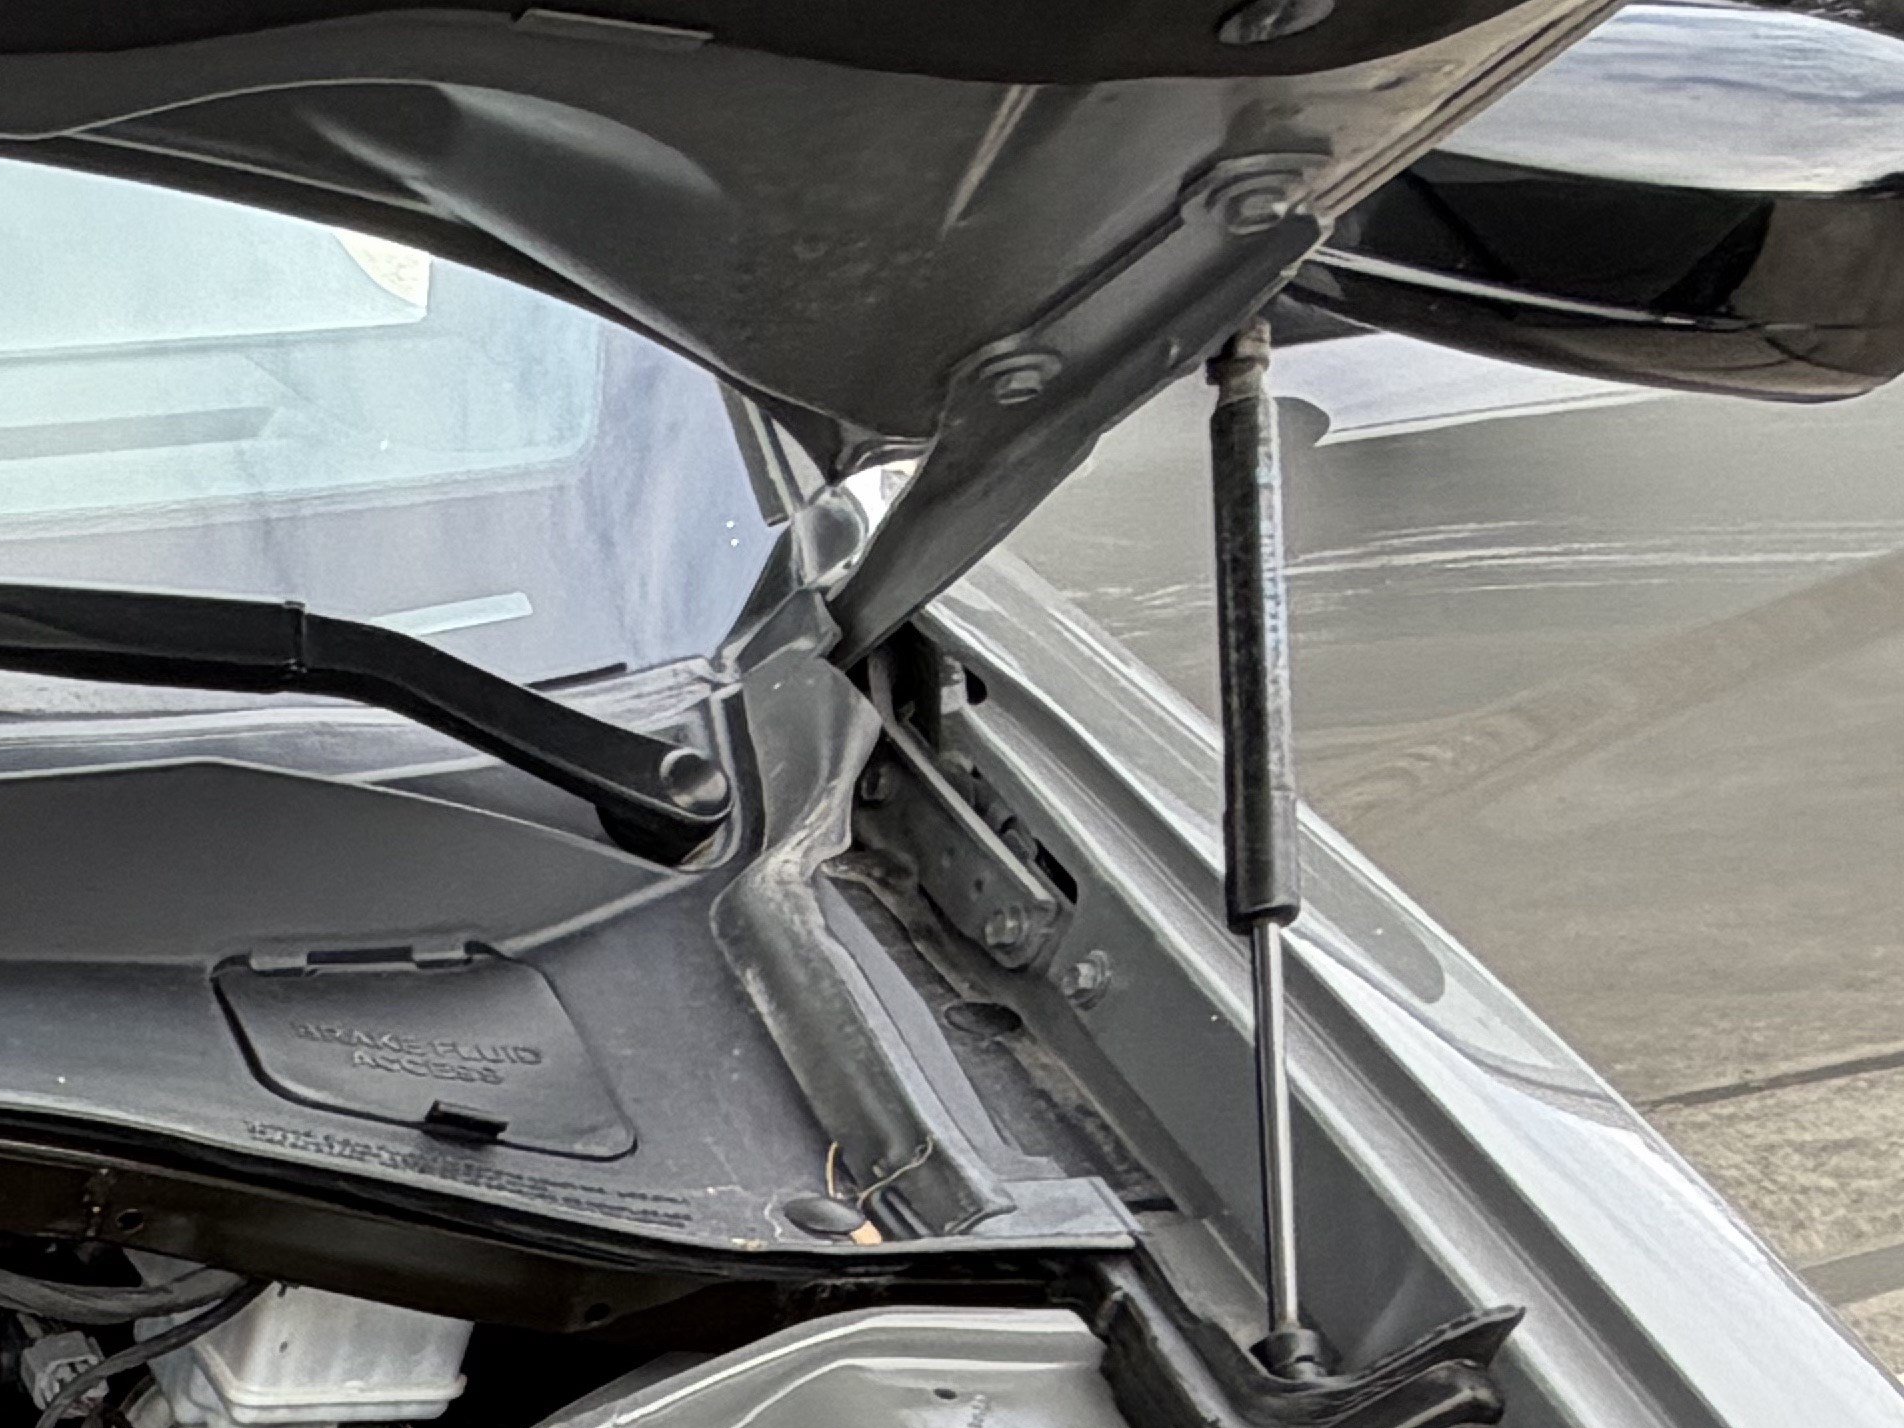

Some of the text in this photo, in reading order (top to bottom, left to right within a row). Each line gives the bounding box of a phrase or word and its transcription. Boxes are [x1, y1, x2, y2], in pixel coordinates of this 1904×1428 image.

[292, 1022, 543, 1066] BRAKE FLUID
[352, 1050, 505, 1085] ACCESS
